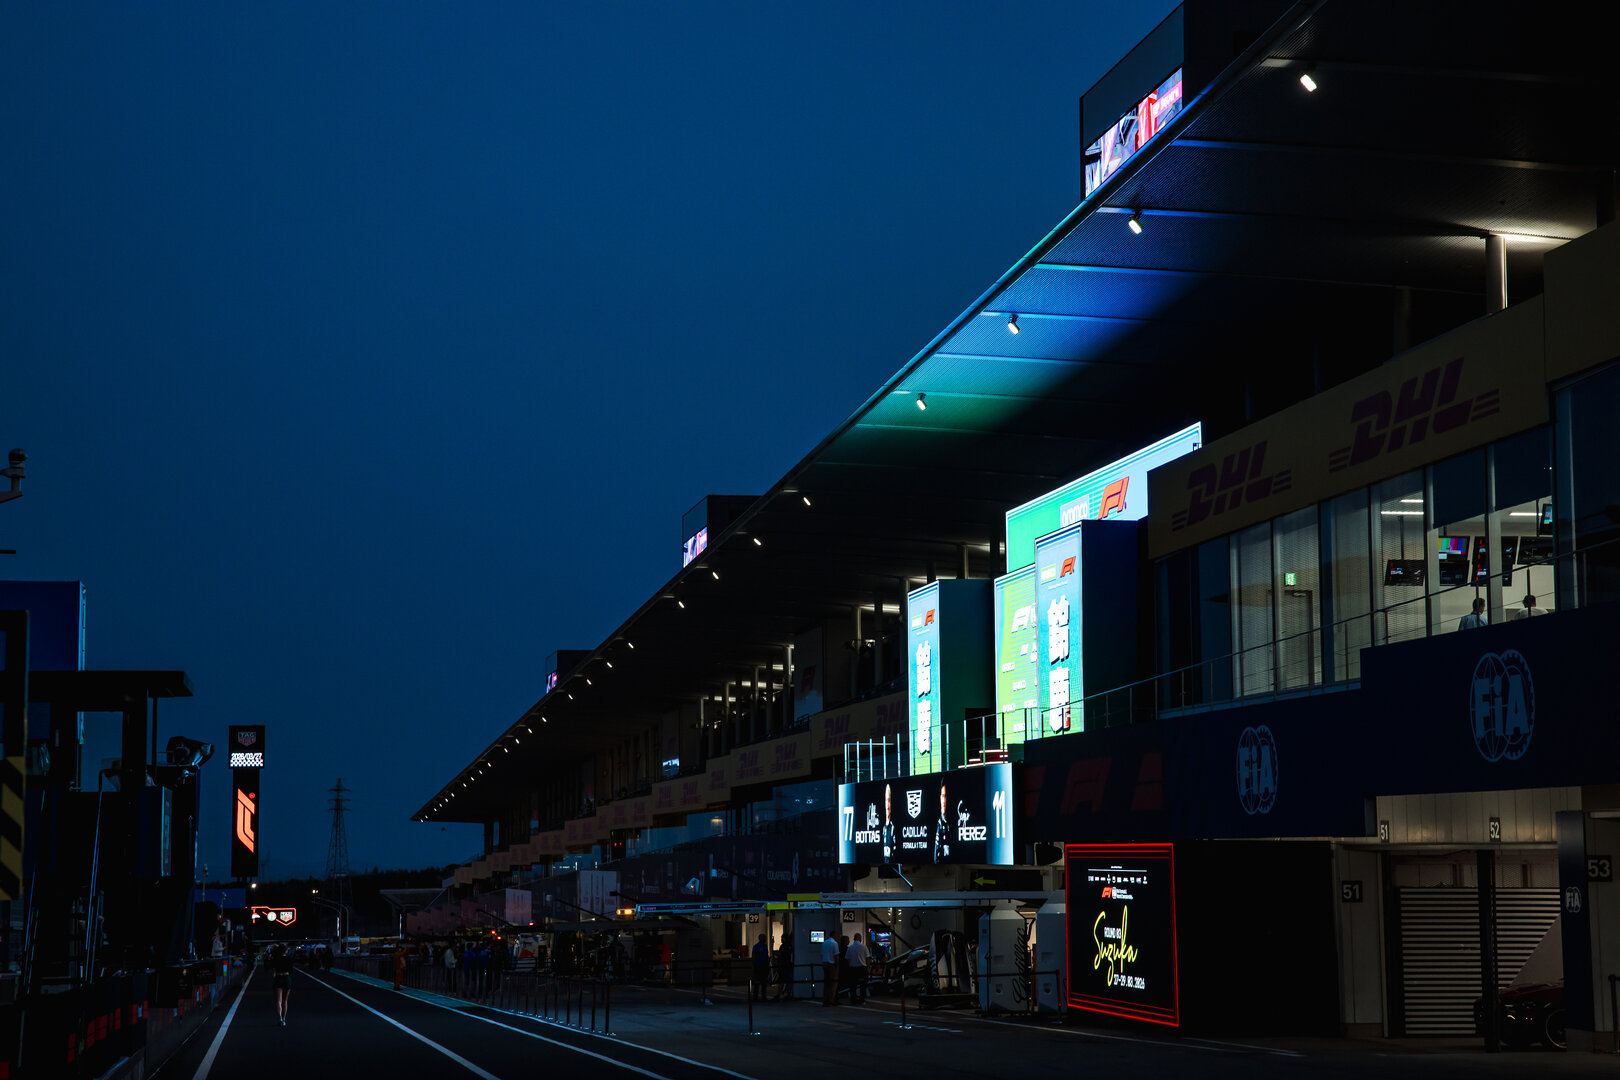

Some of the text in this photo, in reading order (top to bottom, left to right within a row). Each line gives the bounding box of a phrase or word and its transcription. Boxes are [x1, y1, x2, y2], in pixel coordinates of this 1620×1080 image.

[1349, 357, 1473, 467] DHL
[1187, 440, 1274, 527] DHL
[992, 790, 1006, 839] 11
[843, 806, 854, 841] 77
[1490, 821, 1500, 840] 52
[855, 830, 881, 844] BOTTAS
[902, 826, 928, 838] CADILLAC
[958, 826, 987, 841] PEREZ
[1380, 824, 1389, 840] 51
[917, 841, 928, 849] TEAM
[1588, 859, 1611, 878] 53
[1343, 884, 1360, 900] 51
[749, 914, 759, 922] 39
[843, 912, 854, 921] 43
[1104, 927, 1116, 939] ROUND
[1093, 905, 1138, 987] Suzuka
